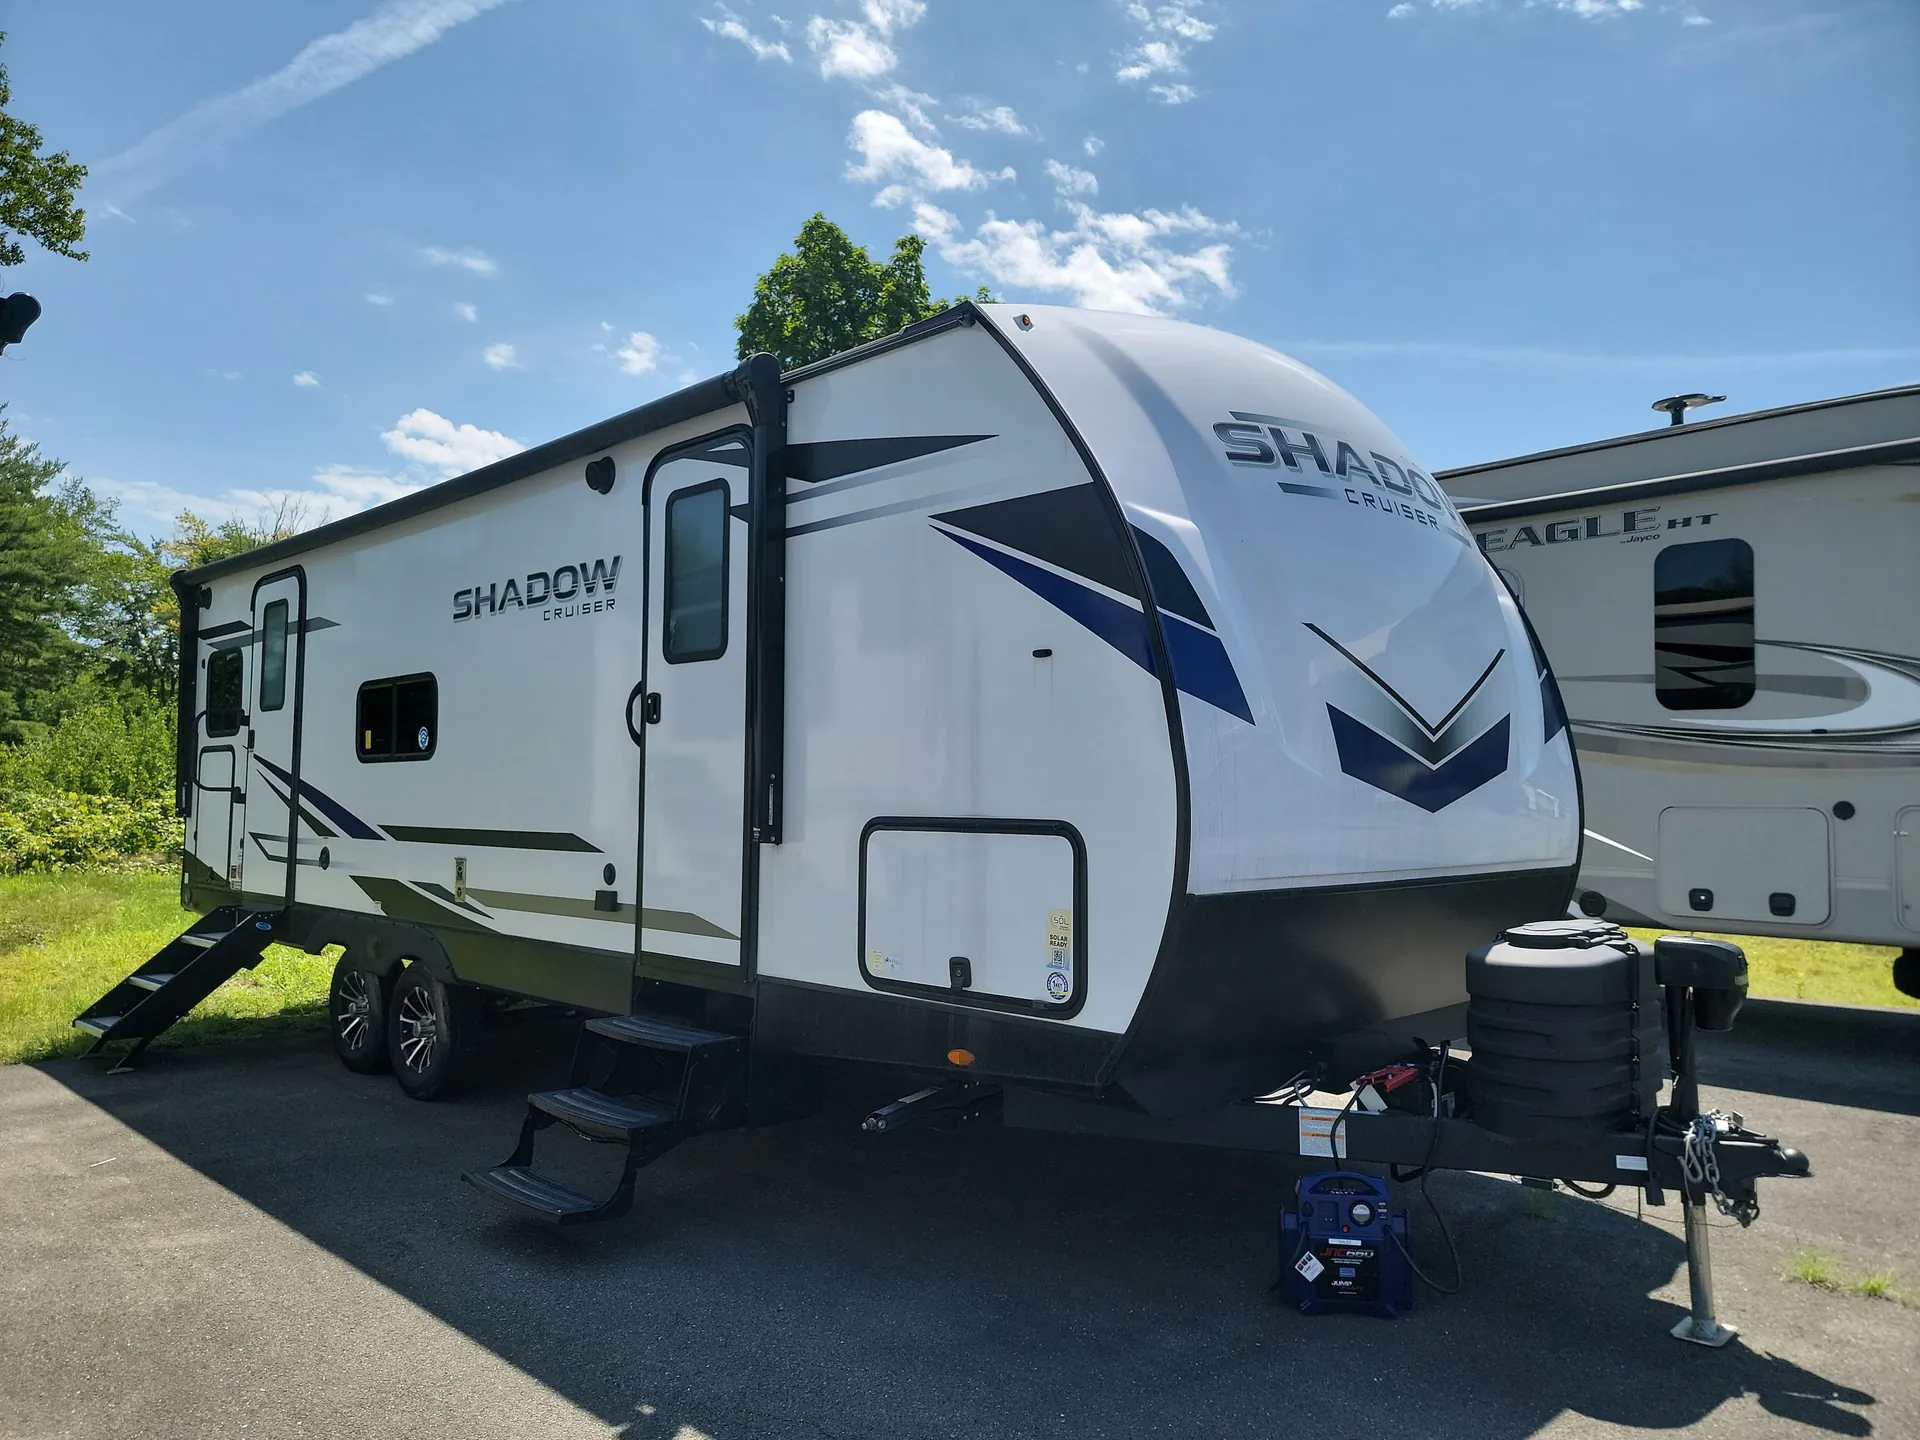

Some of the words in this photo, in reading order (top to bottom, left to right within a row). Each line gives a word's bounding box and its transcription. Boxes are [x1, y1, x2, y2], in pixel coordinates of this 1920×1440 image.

[1344, 487, 1440, 531] CRUISER
[1476, 506, 1661, 553] EAGLE
[1667, 513, 1719, 530] HT
[1626, 533, 1660, 543] Jayco
[453, 554, 623, 623] SHADOW
[543, 598, 616, 622] CRUISER
[1049, 934, 1069, 942] SOLAR
